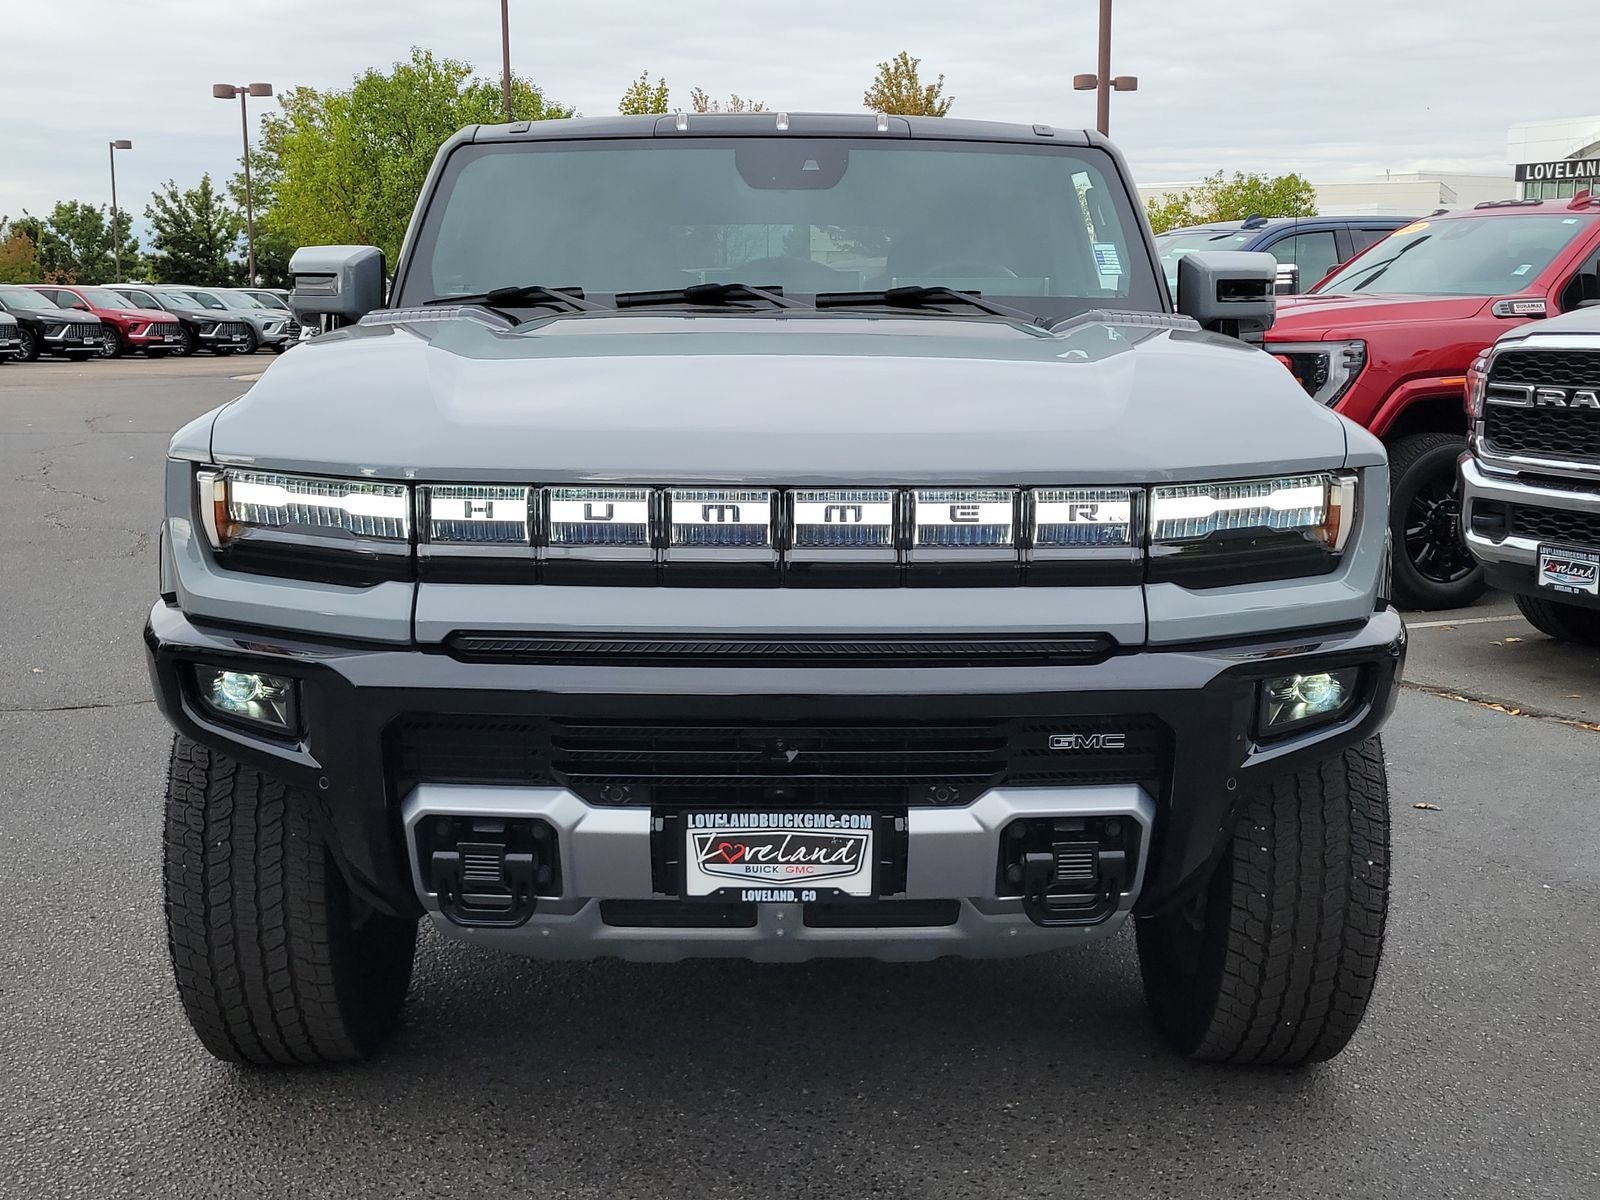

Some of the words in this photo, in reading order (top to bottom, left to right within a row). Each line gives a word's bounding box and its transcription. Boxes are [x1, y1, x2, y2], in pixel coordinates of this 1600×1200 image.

[1525, 160, 1600, 180] LOVELAN
[464, 500, 1099, 522] HUMMER
[1049, 733, 1126, 750] GMC
[687, 813, 872, 829] LOVELANDBUICKGMC.COM
[745, 865, 779, 874] BUICK
[785, 865, 814, 874] GMC
[741, 890, 798, 902] LOVELAND,
[801, 890, 817, 902] CO
